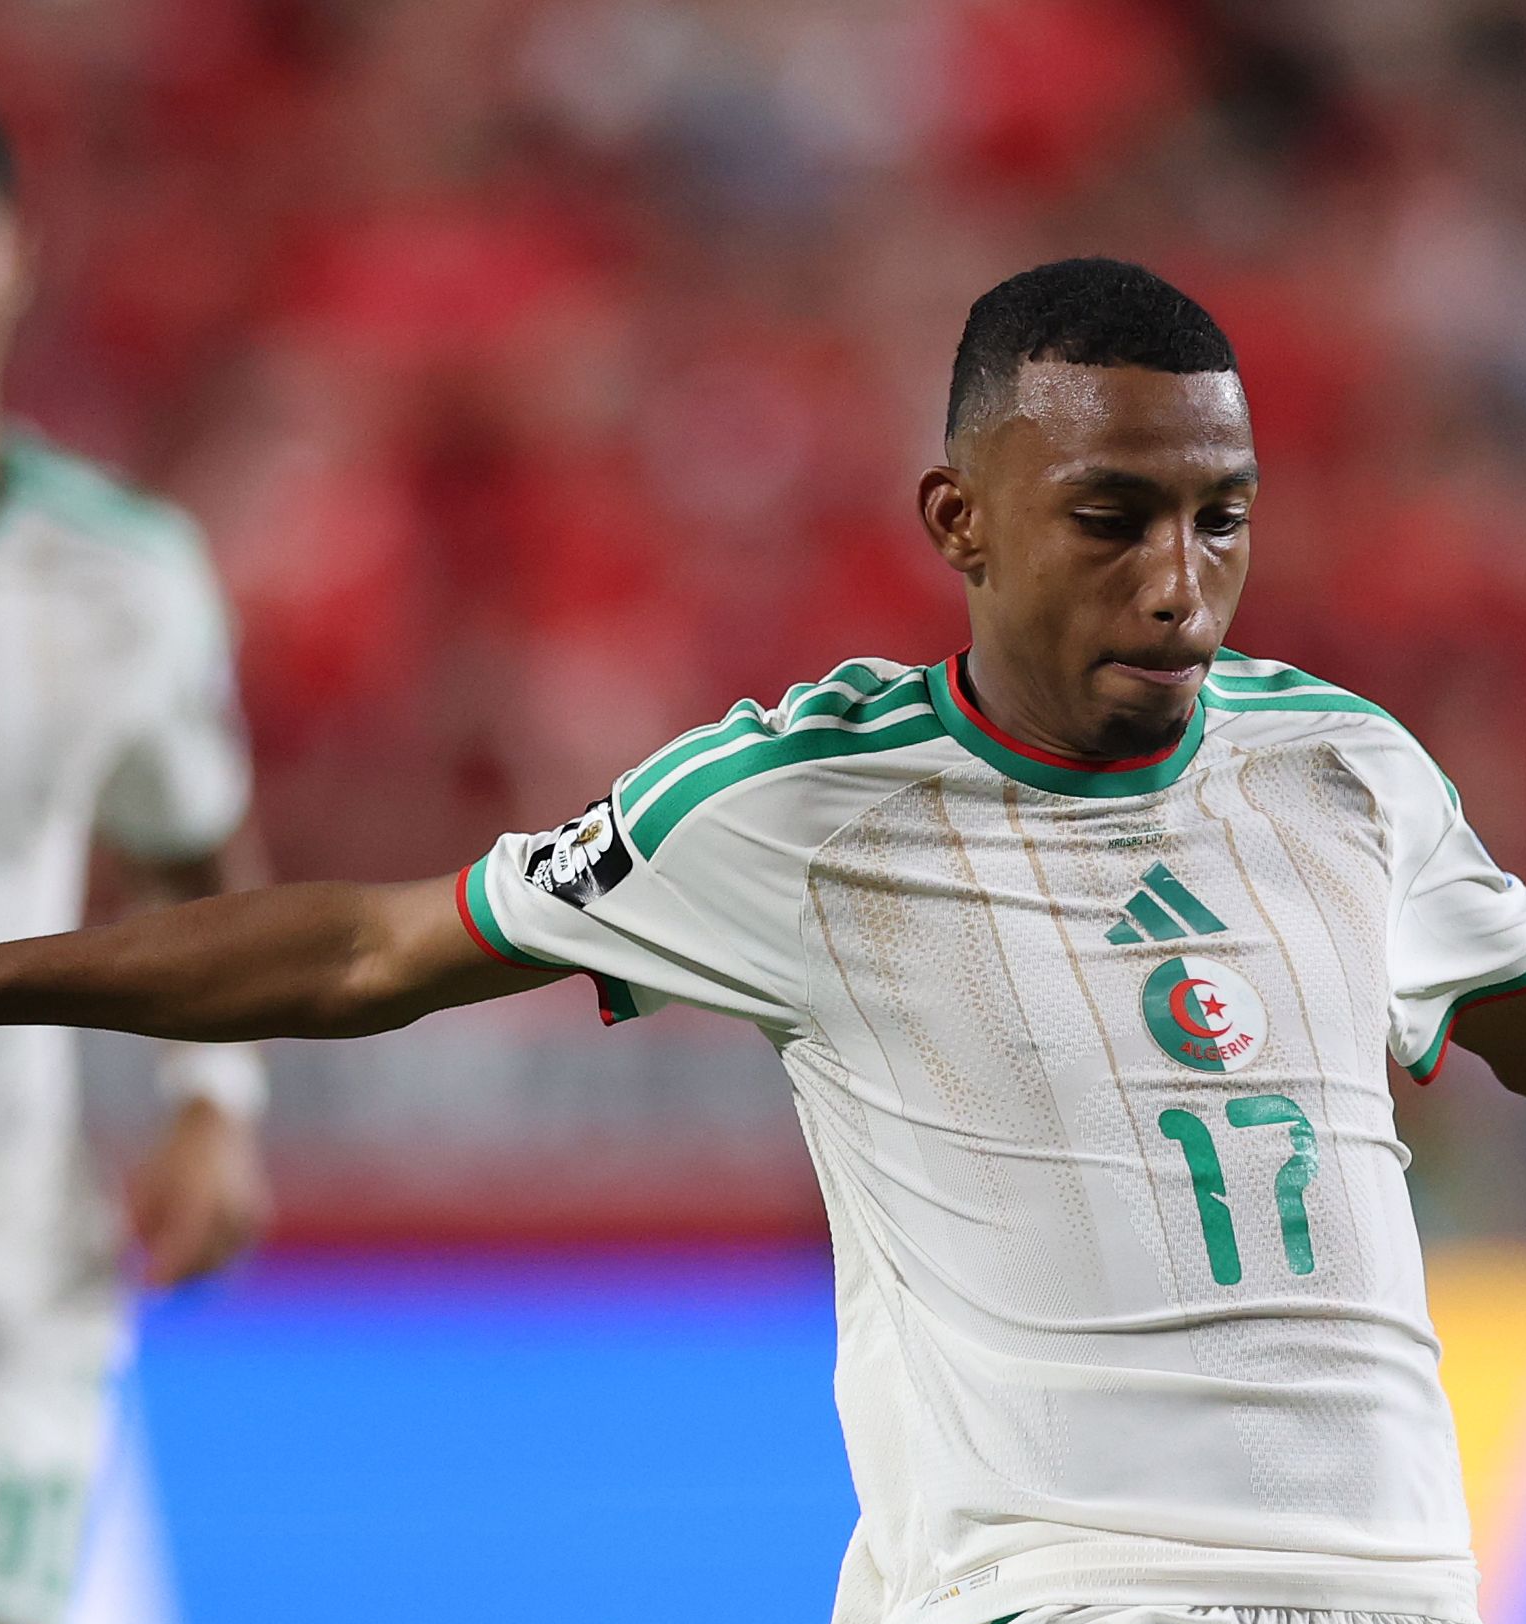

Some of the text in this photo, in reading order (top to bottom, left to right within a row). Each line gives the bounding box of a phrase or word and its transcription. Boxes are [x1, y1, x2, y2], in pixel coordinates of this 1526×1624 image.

[558, 850, 569, 871] FIFA
[1180, 1032, 1254, 1061] ALGERIA
[1158, 1094, 1318, 1286] 17
